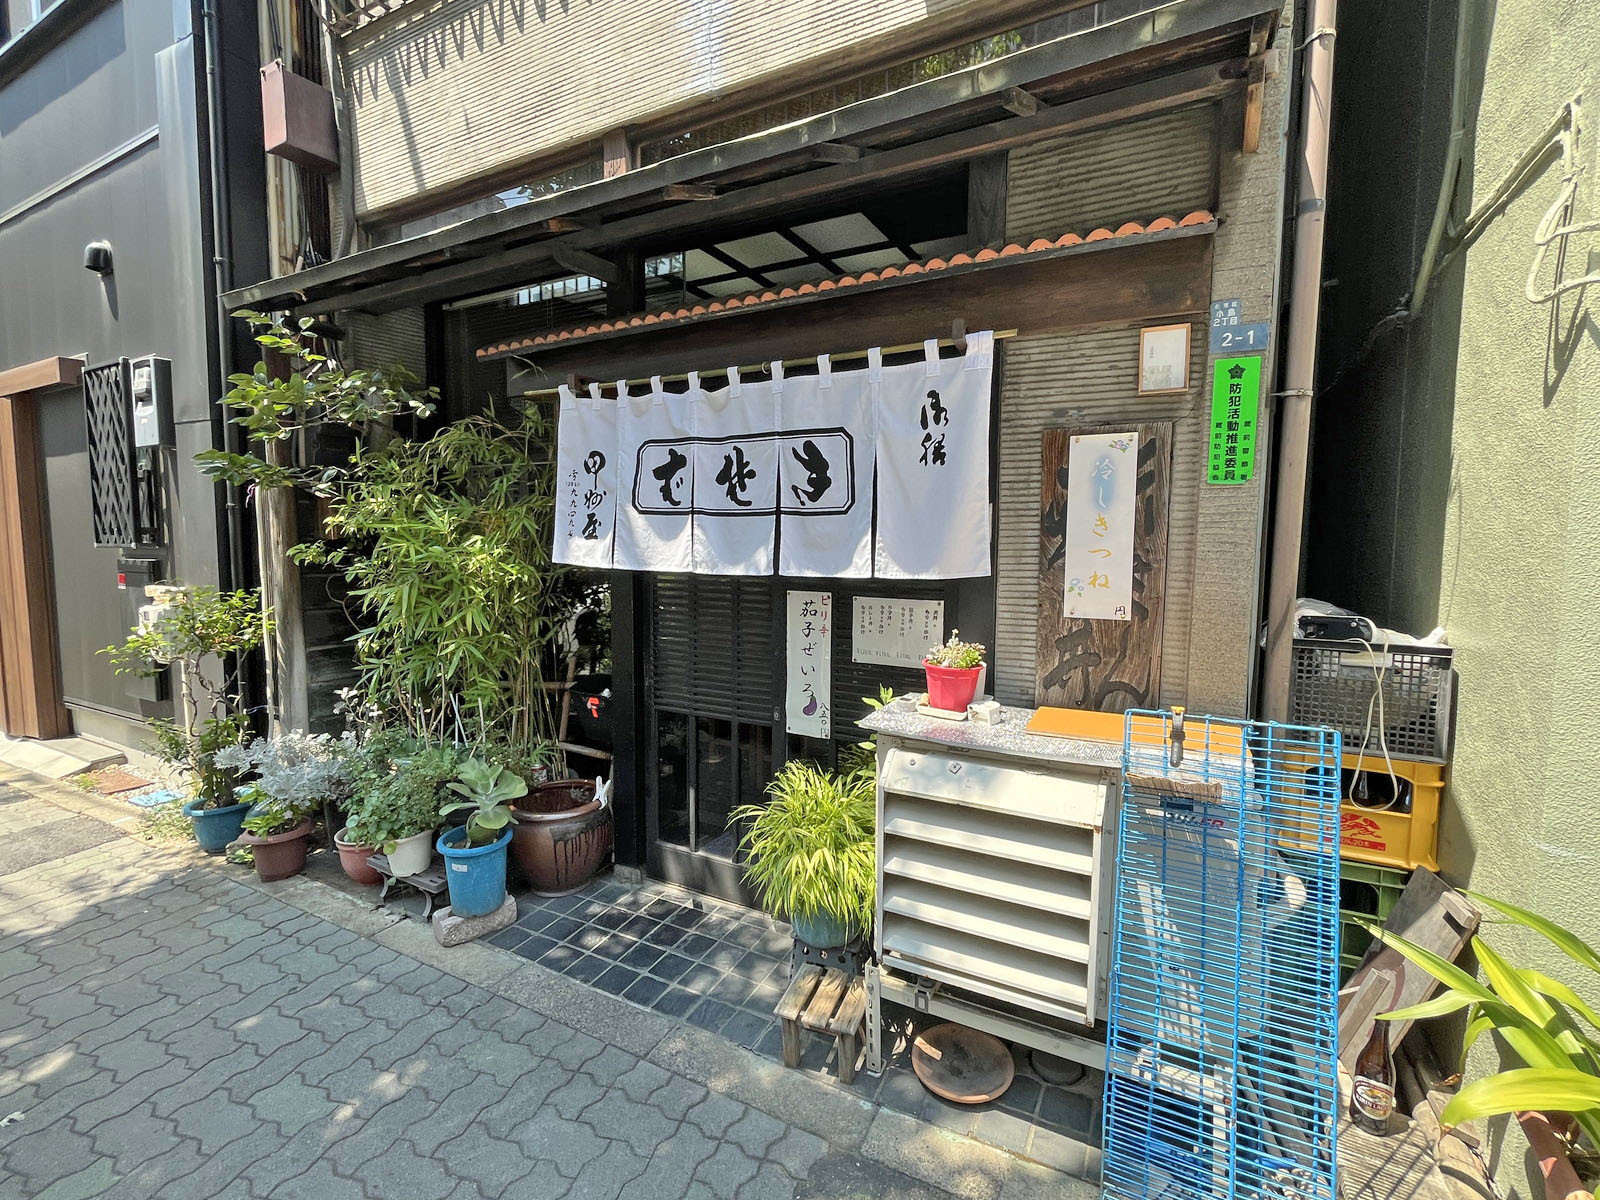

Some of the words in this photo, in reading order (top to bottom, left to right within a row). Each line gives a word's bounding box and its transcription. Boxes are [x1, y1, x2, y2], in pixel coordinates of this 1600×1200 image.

[1213, 316, 1238, 327] 2丁目
[1215, 308, 1236, 318] 小島
[1221, 329, 1255, 347] 2-1
[1223, 382, 1243, 481] 防犯活動推進委員
[582, 450, 607, 541] 甲州屋
[1087, 457, 1118, 589] 冷しきつね
[799, 599, 818, 698] 茄子ぜいろ
[819, 594, 831, 638] ピリ辛
